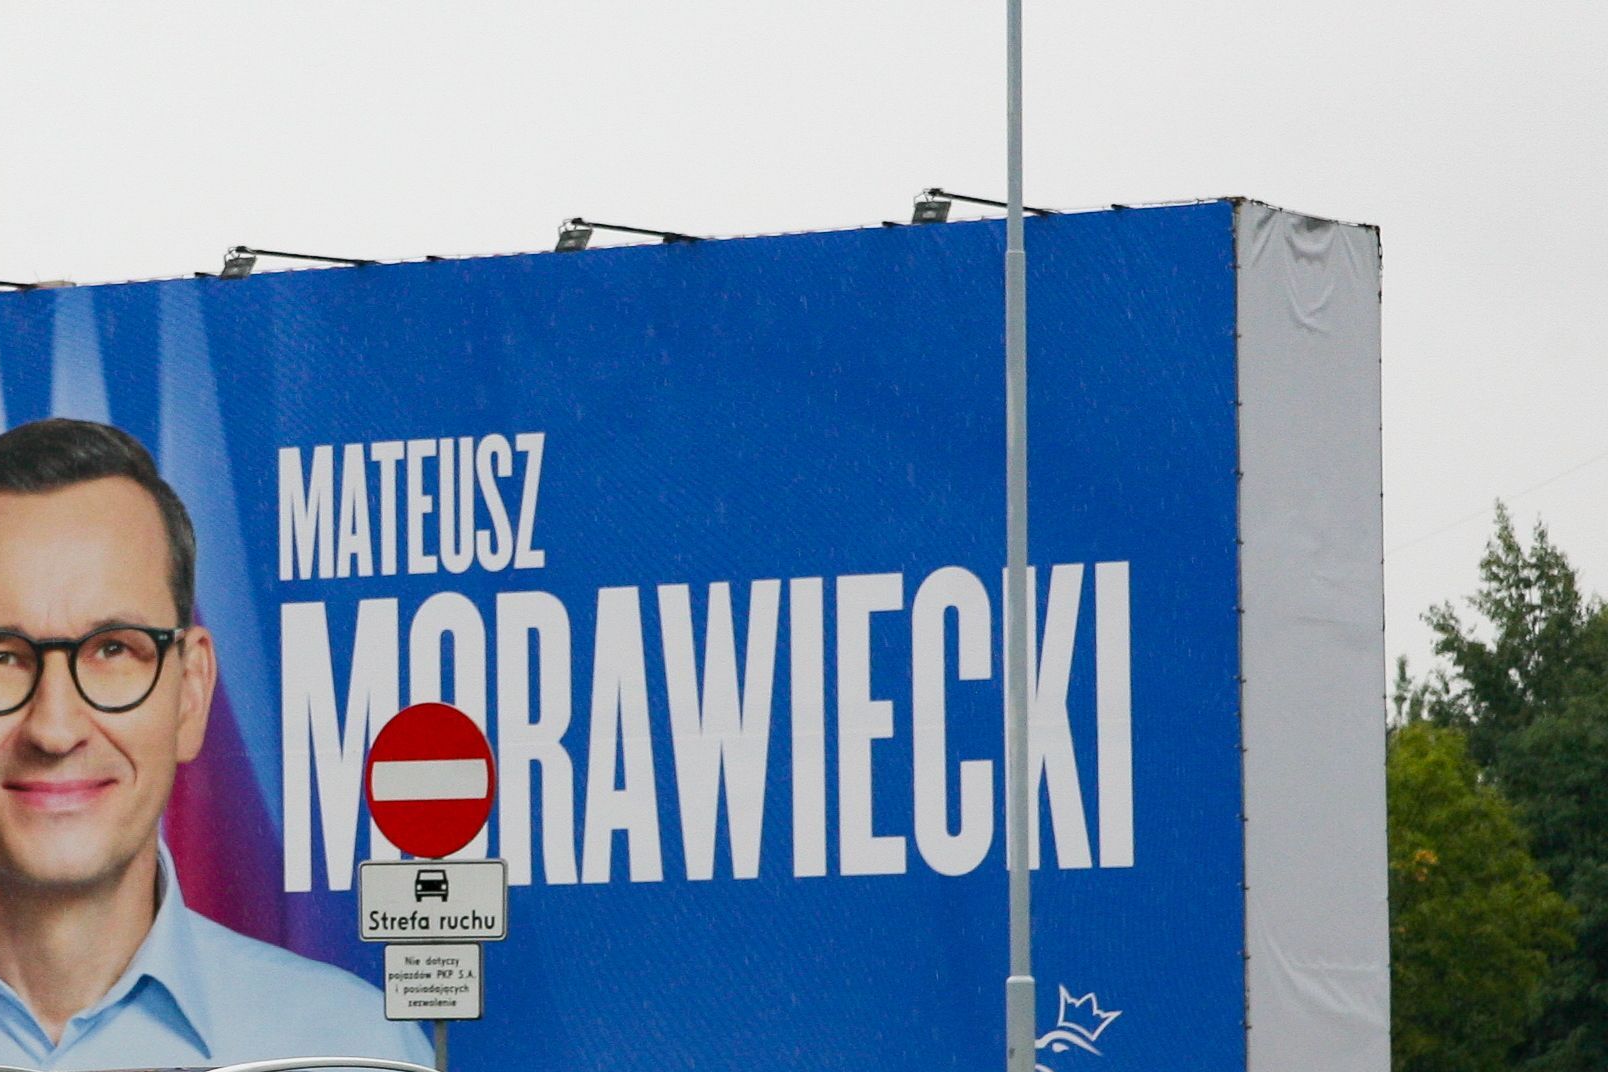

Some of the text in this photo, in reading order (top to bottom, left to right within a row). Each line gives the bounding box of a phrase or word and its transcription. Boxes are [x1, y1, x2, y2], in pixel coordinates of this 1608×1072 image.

[278, 432, 546, 582] MATEUSZ
[368, 910, 496, 931] Strefa ruchu
[405, 956, 460, 967] Nie dotyczy
[388, 970, 432, 981] pojazdów
[437, 969, 454, 979] PKP
[395, 984, 399, 994] i
